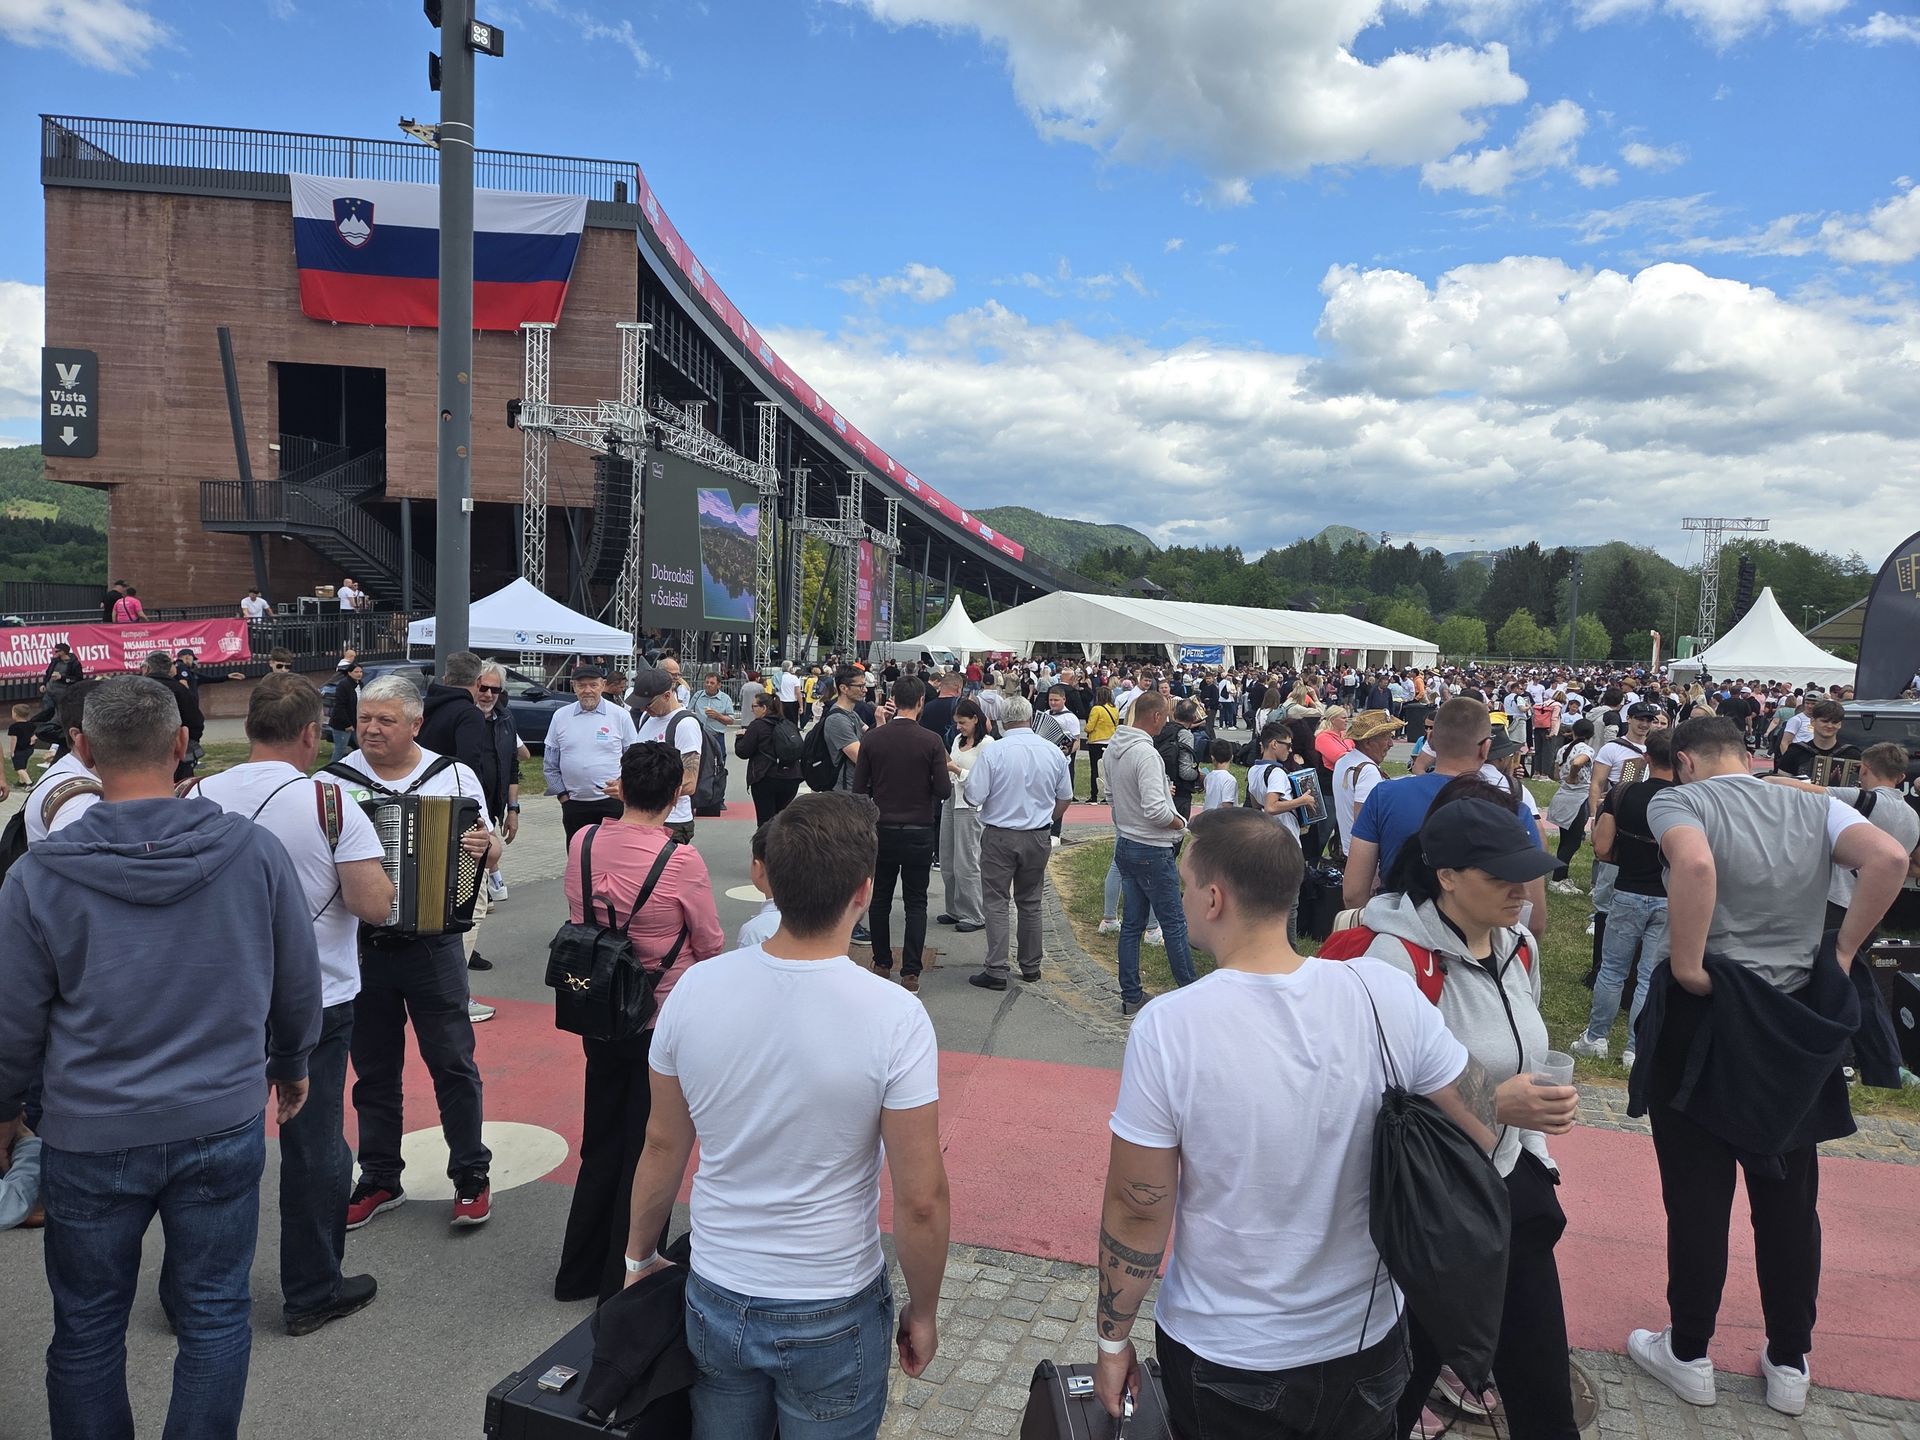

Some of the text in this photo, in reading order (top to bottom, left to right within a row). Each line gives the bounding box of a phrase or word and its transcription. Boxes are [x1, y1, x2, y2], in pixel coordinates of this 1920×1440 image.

[50, 390, 87, 402] Vista
[50, 404, 87, 418] BAR
[651, 563, 694, 585] Dobrodošli
[650, 593, 657, 604] v
[11, 632, 69, 651] PRAZNIK
[123, 640, 157, 650] ANSAMBEL
[536, 634, 575, 645] Selmar
[77, 644, 110, 661] VISTI
[1125, 1265, 1154, 1280] DON'T
